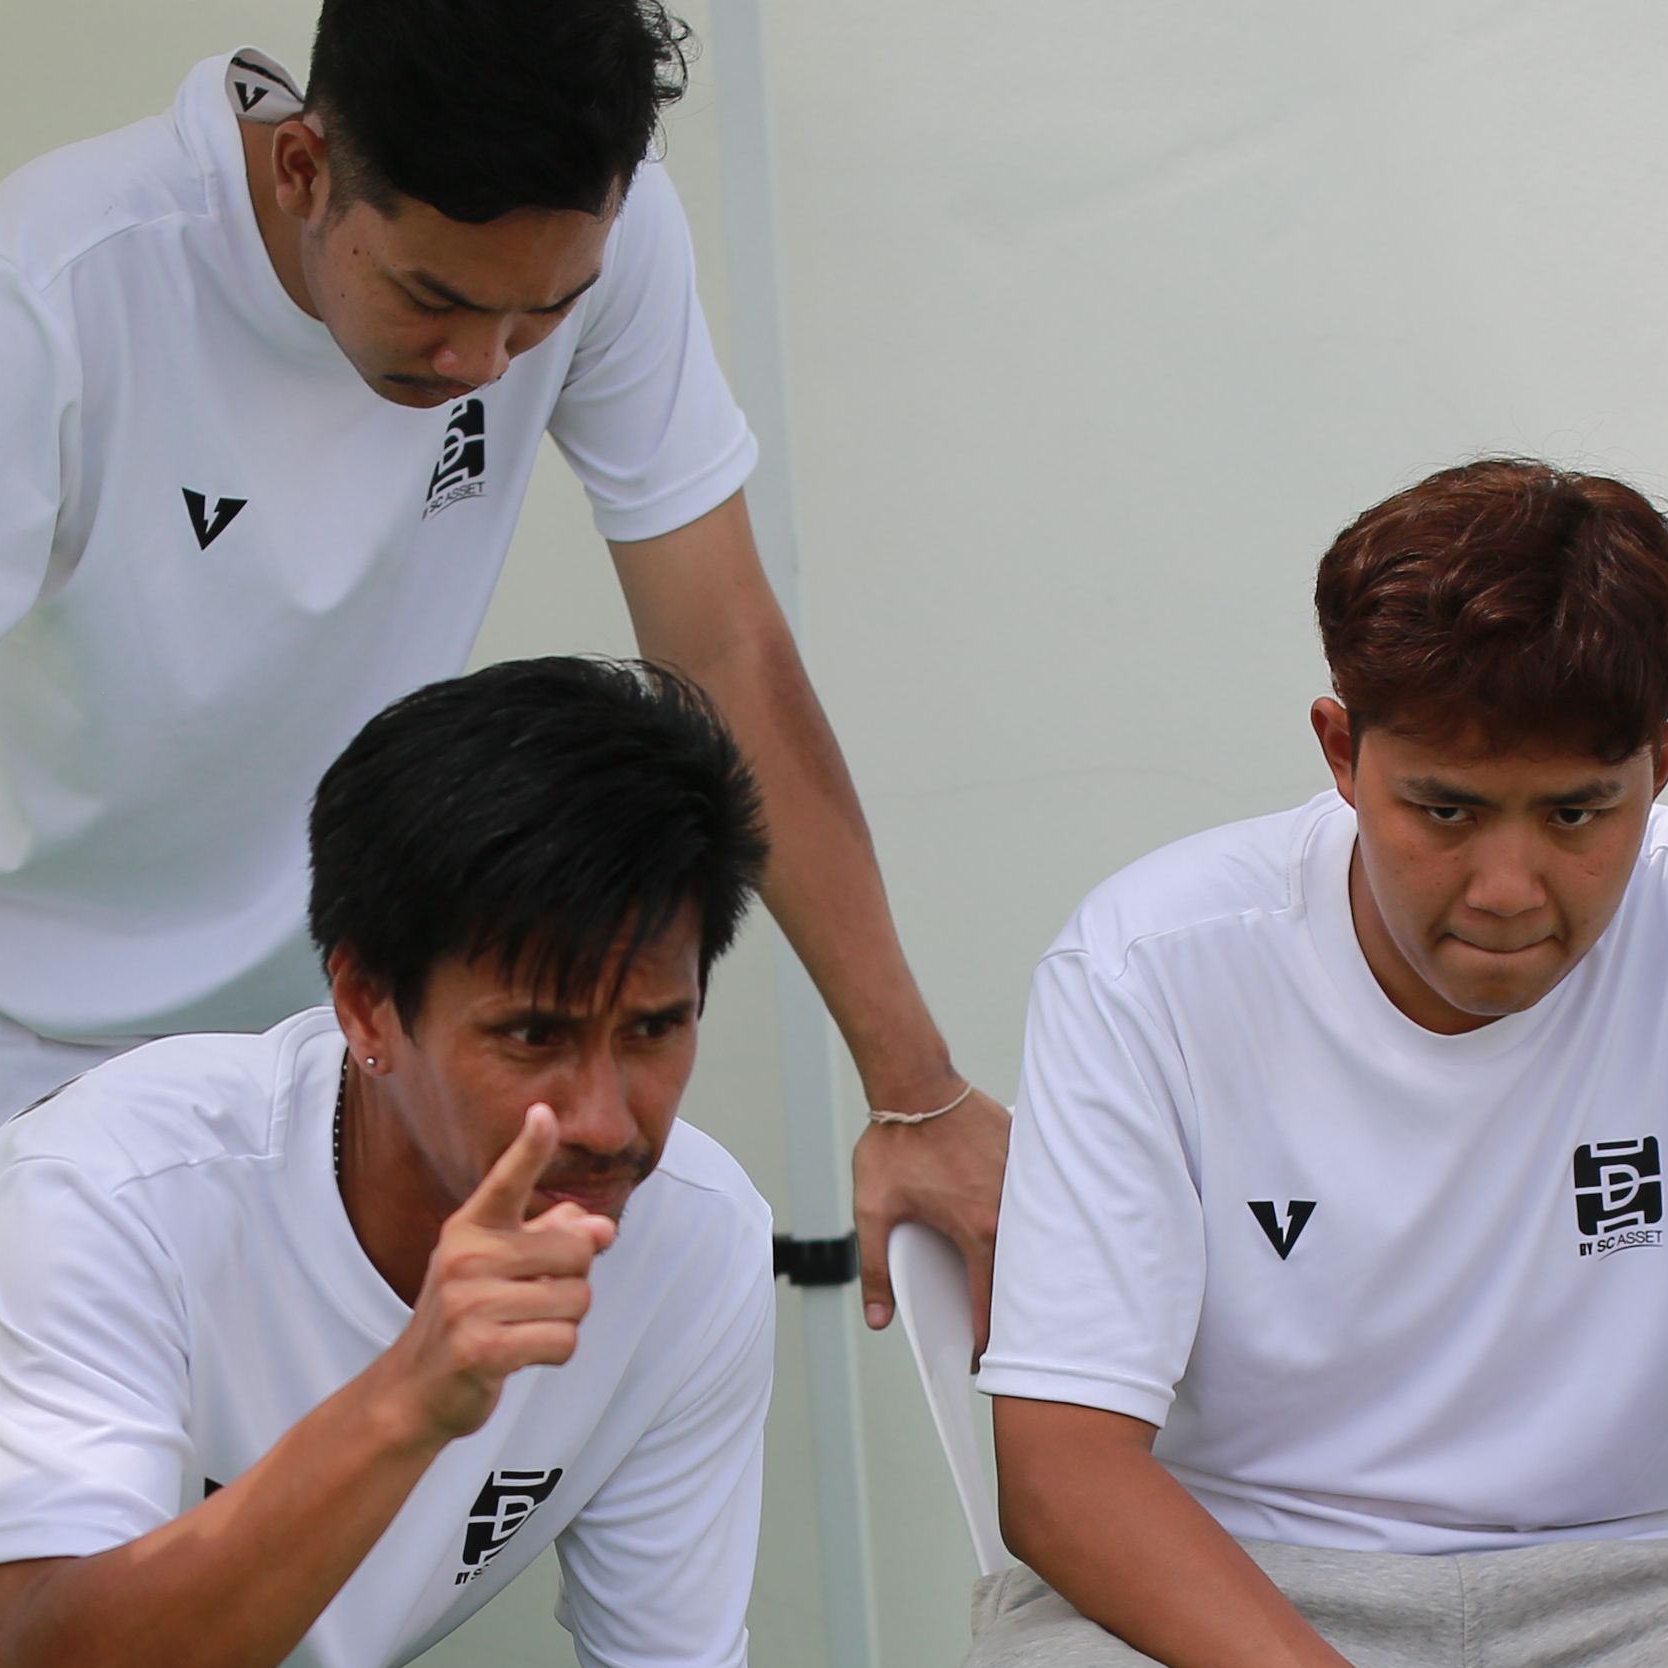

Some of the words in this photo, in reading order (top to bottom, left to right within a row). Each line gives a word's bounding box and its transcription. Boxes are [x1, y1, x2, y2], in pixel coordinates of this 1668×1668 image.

[1579, 1241, 1593, 1257] BY
[1596, 1236, 1616, 1253] SC
[1617, 1230, 1663, 1246] ASSET
